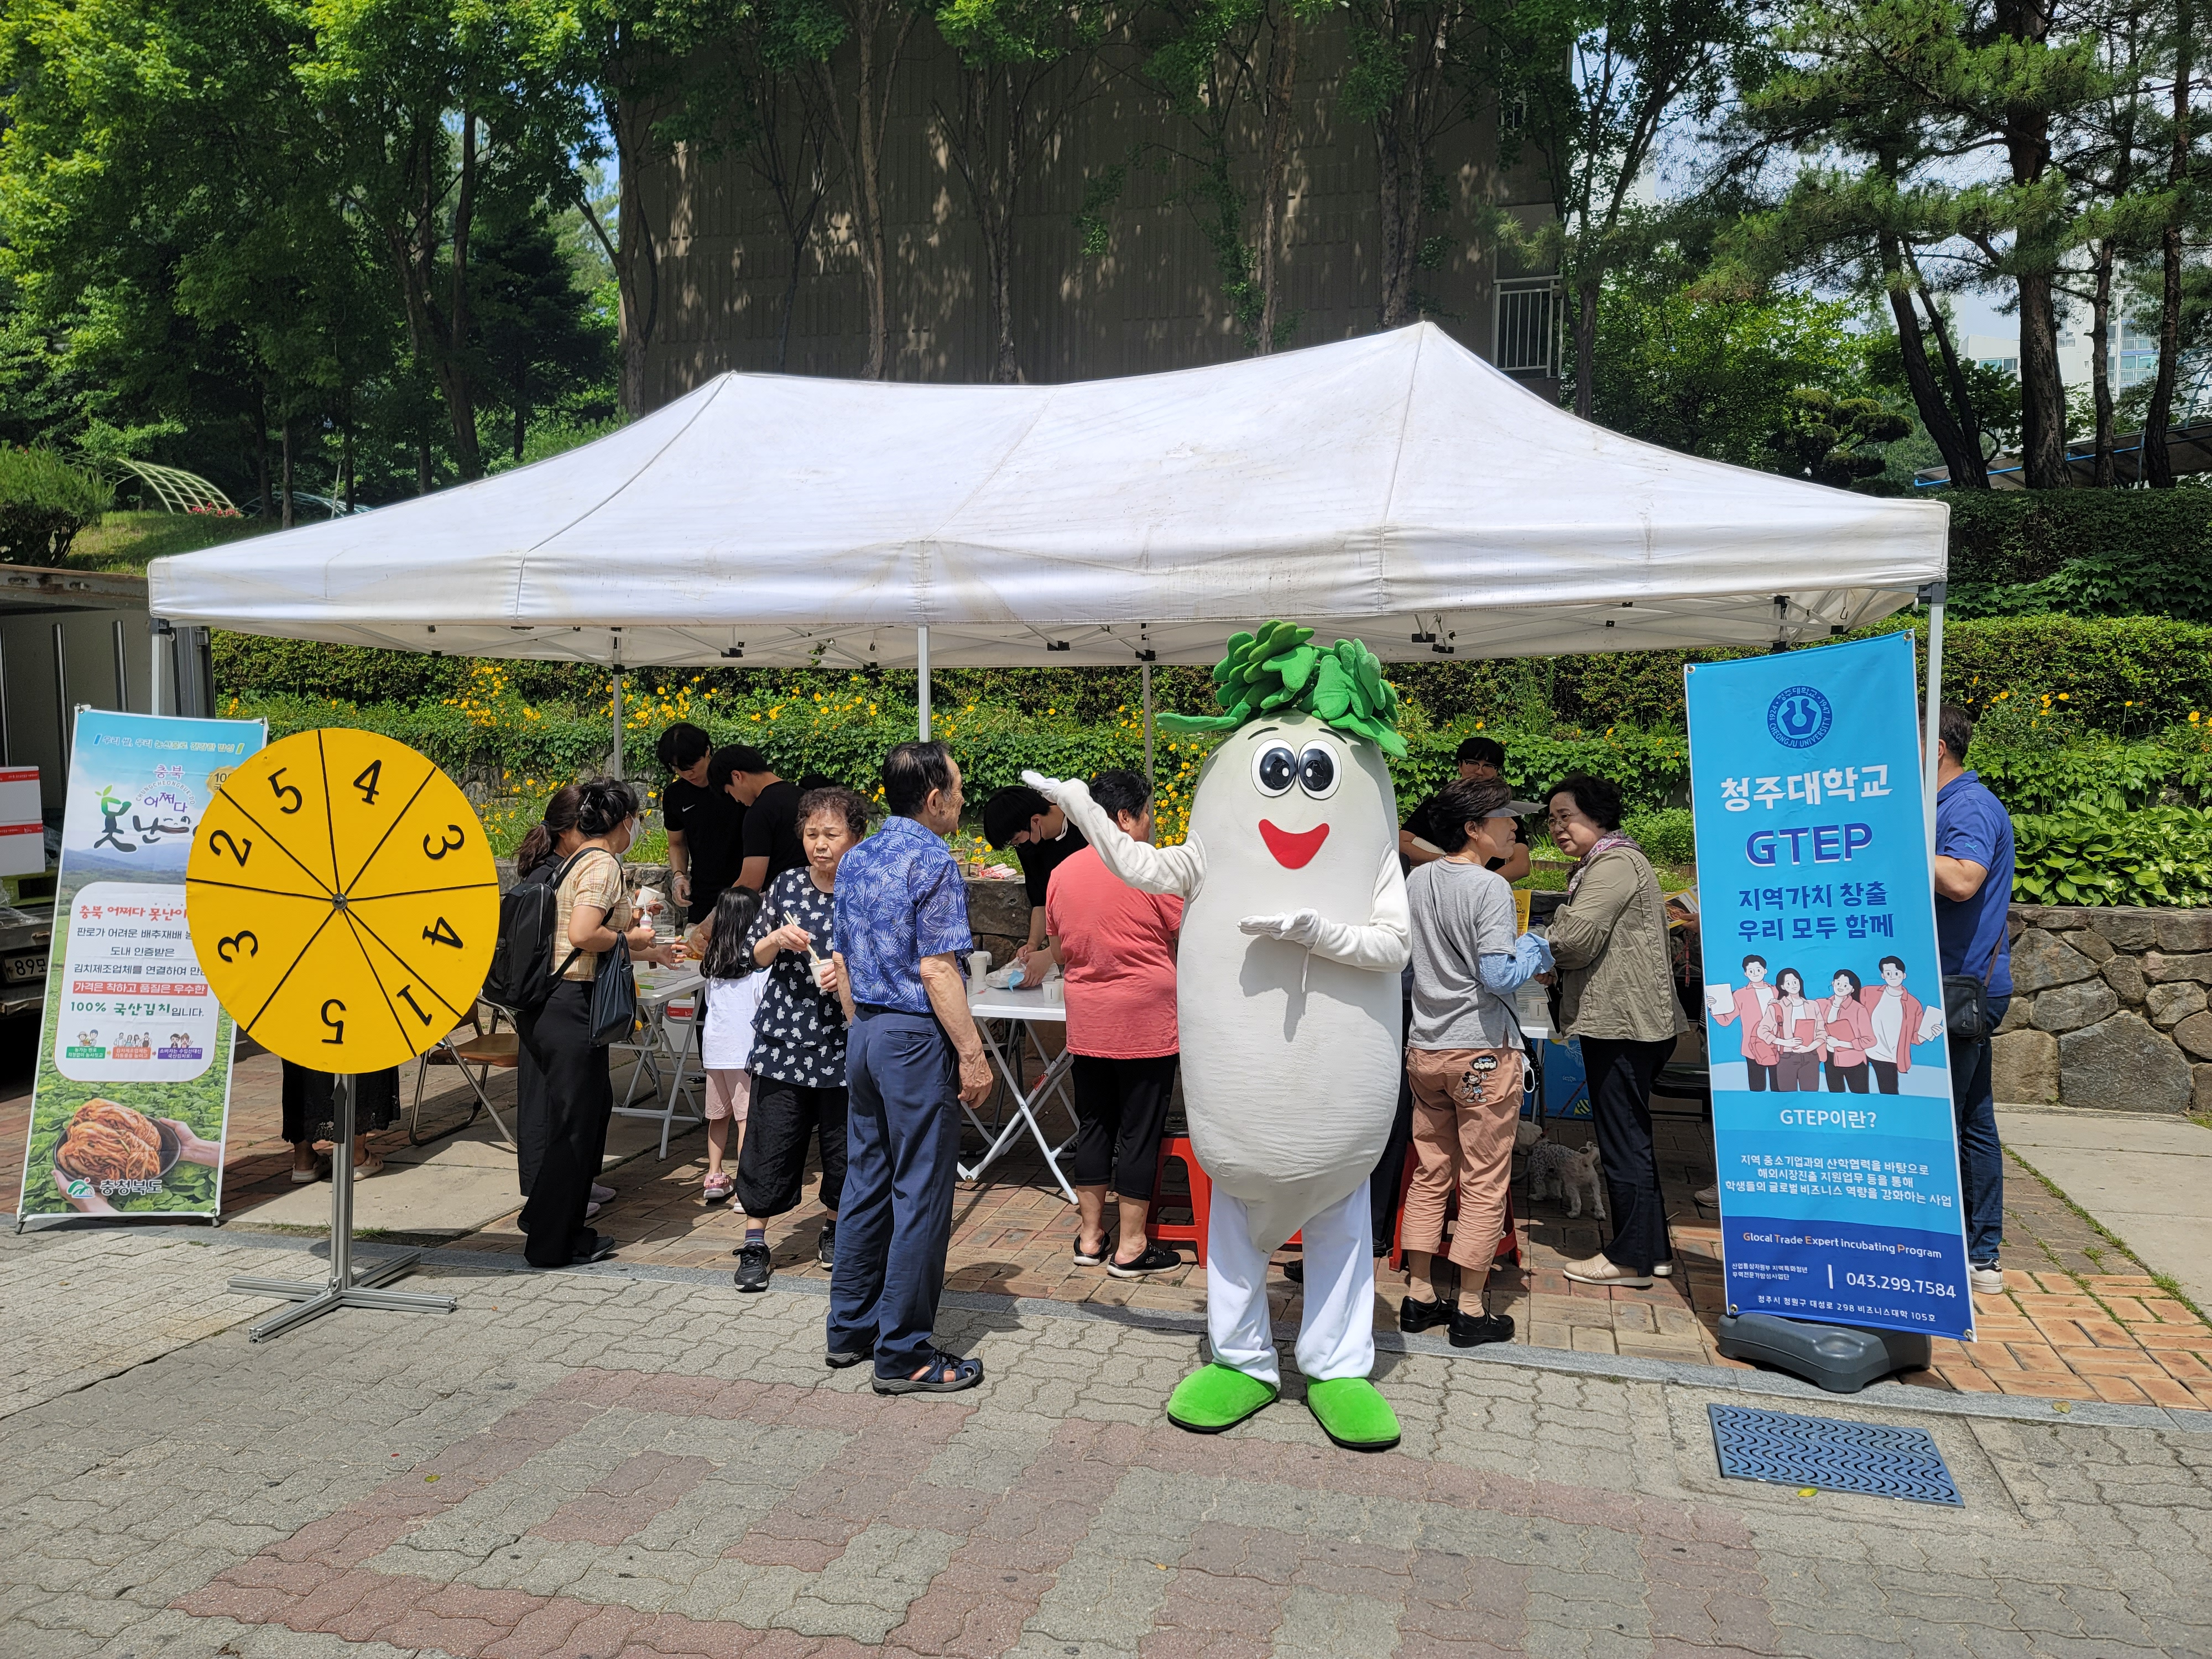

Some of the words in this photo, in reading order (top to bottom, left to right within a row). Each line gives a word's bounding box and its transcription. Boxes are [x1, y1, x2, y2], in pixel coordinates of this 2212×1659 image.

[1777, 687, 1818, 701] 청주대학교
[1769, 705, 1778, 721] 1924
[1819, 699, 1830, 714] 1947
[1769, 723, 1798, 747] CHEONGJU
[1799, 717, 1831, 747] UNIVERSITY
[103, 736, 119, 744] 우리
[135, 738, 152, 747] 우리
[155, 740, 188, 749] 농산물로
[190, 742, 215, 752] 건강한
[218, 743, 234, 753] 밥상
[154, 765, 184, 779] 충북
[353, 759, 383, 805] 4
[268, 767, 302, 814] 5
[1721, 764, 1893, 812] 청주대학교
[144, 792, 187, 812] 어쩌다
[209, 830, 253, 867] 2
[422, 824, 465, 860] 3
[1746, 823, 1872, 867] GTEP
[1739, 884, 1833, 911] 지역가치
[1840, 881, 1888, 907] 창출
[80, 905, 103, 919] 충북
[107, 906, 145, 917] 어쩌다
[77, 927, 105, 937] 판로가
[108, 928, 138, 938] 어려운
[141, 930, 182, 940] 배추재배
[422, 916, 464, 949] 4
[1738, 918, 1784, 942] 우리
[1792, 917, 1840, 940] 모두
[1845, 914, 1894, 938] 함께
[111, 947, 131, 956] 도내
[134, 948, 175, 957] 인증받은
[217, 930, 259, 963] 3
[74, 964, 142, 974] 김치제조업체를
[146, 966, 186, 975] 연결하여
[75, 982, 103, 992] 가격은
[107, 983, 136, 993] 착하고
[140, 984, 171, 994] 품질은
[174, 985, 206, 994] 우수한
[71, 1001, 107, 1012] 100%
[397, 984, 432, 1027] 1
[320, 999, 347, 1045] 5
[1474, 1061, 1496, 1070] GOOD!
[1780, 1109, 1877, 1129] GTEP이란?
[1741, 1155, 1761, 1166] 지역
[1764, 1155, 1823, 1169] 중소기업과의
[1827, 1158, 1881, 1172] 산학협력을
[1884, 1162, 1929, 1175] 바탕으로
[100, 1179, 163, 1196] 충청북도
[1758, 1168, 1818, 1182] 해외시장진출
[1820, 1171, 1864, 1184] 지원업무
[1867, 1173, 1888, 1186] 등을
[1891, 1176, 1913, 1188] 통해
[1725, 1181, 1766, 1192] 학생들의
[1769, 1182, 1798, 1194] 글로벌
[1800, 1185, 1843, 1196] 비즈니스
[1845, 1186, 1878, 1199] 역량을
[1881, 1190, 1926, 1204] 강화하는
[1929, 1194, 1952, 1208] 사업
[1743, 1233, 1773, 1243] Glocal
[1774, 1234, 1803, 1244] Trade
[1805, 1236, 1839, 1247] Expert
[1897, 1244, 1942, 1259] Program
[1846, 1272, 1957, 1298] 043.299.7584
[1758, 1295, 1781, 1305] 청주시
[1783, 1297, 1806, 1307] 청원구
[1809, 1300, 1833, 1310] 대성로
[1837, 1303, 1855, 1312] 298
[1858, 1305, 1908, 1319] 비즈니스대학
[1911, 1312, 1936, 1322] 105호
